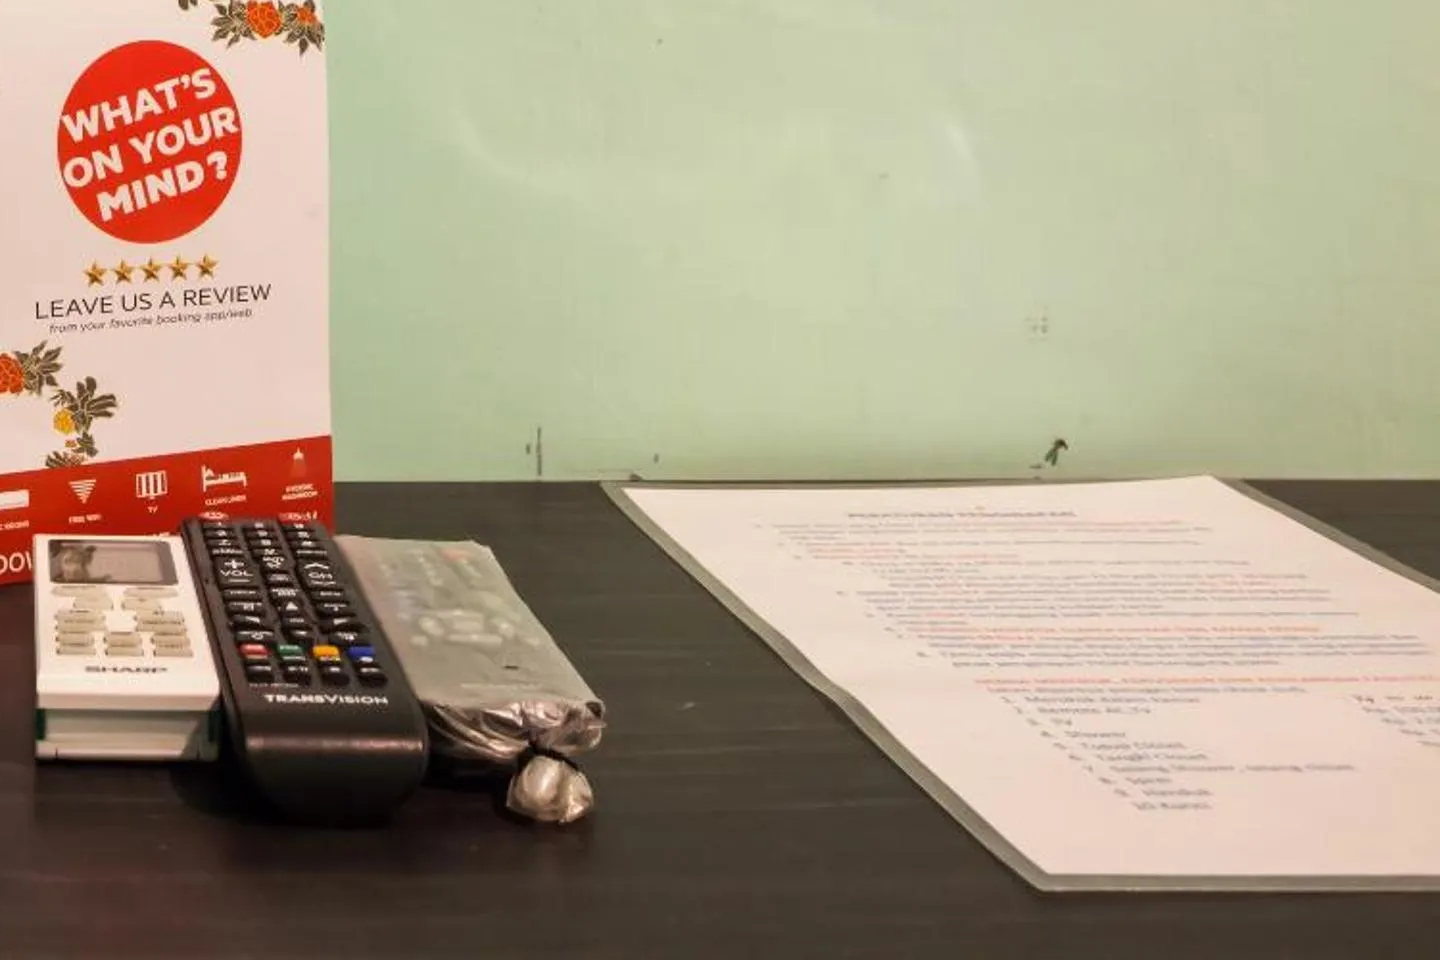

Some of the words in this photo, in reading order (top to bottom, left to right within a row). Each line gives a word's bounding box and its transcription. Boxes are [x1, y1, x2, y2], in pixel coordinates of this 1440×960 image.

[62, 67, 217, 142] WHAT'S
[63, 145, 125, 189] ON
[129, 106, 240, 165] YOUR
[35, 296, 113, 320] LEAVE
[121, 293, 153, 312] US
[159, 291, 177, 309] A
[183, 283, 272, 306] REVIEW
[49, 324, 78, 334] from
[80, 321, 106, 332] your
[109, 317, 153, 329] favorite
[156, 312, 201, 326] booking
[85, 665, 168, 674] SHARP
[263, 693, 389, 705] TRANSVISION
